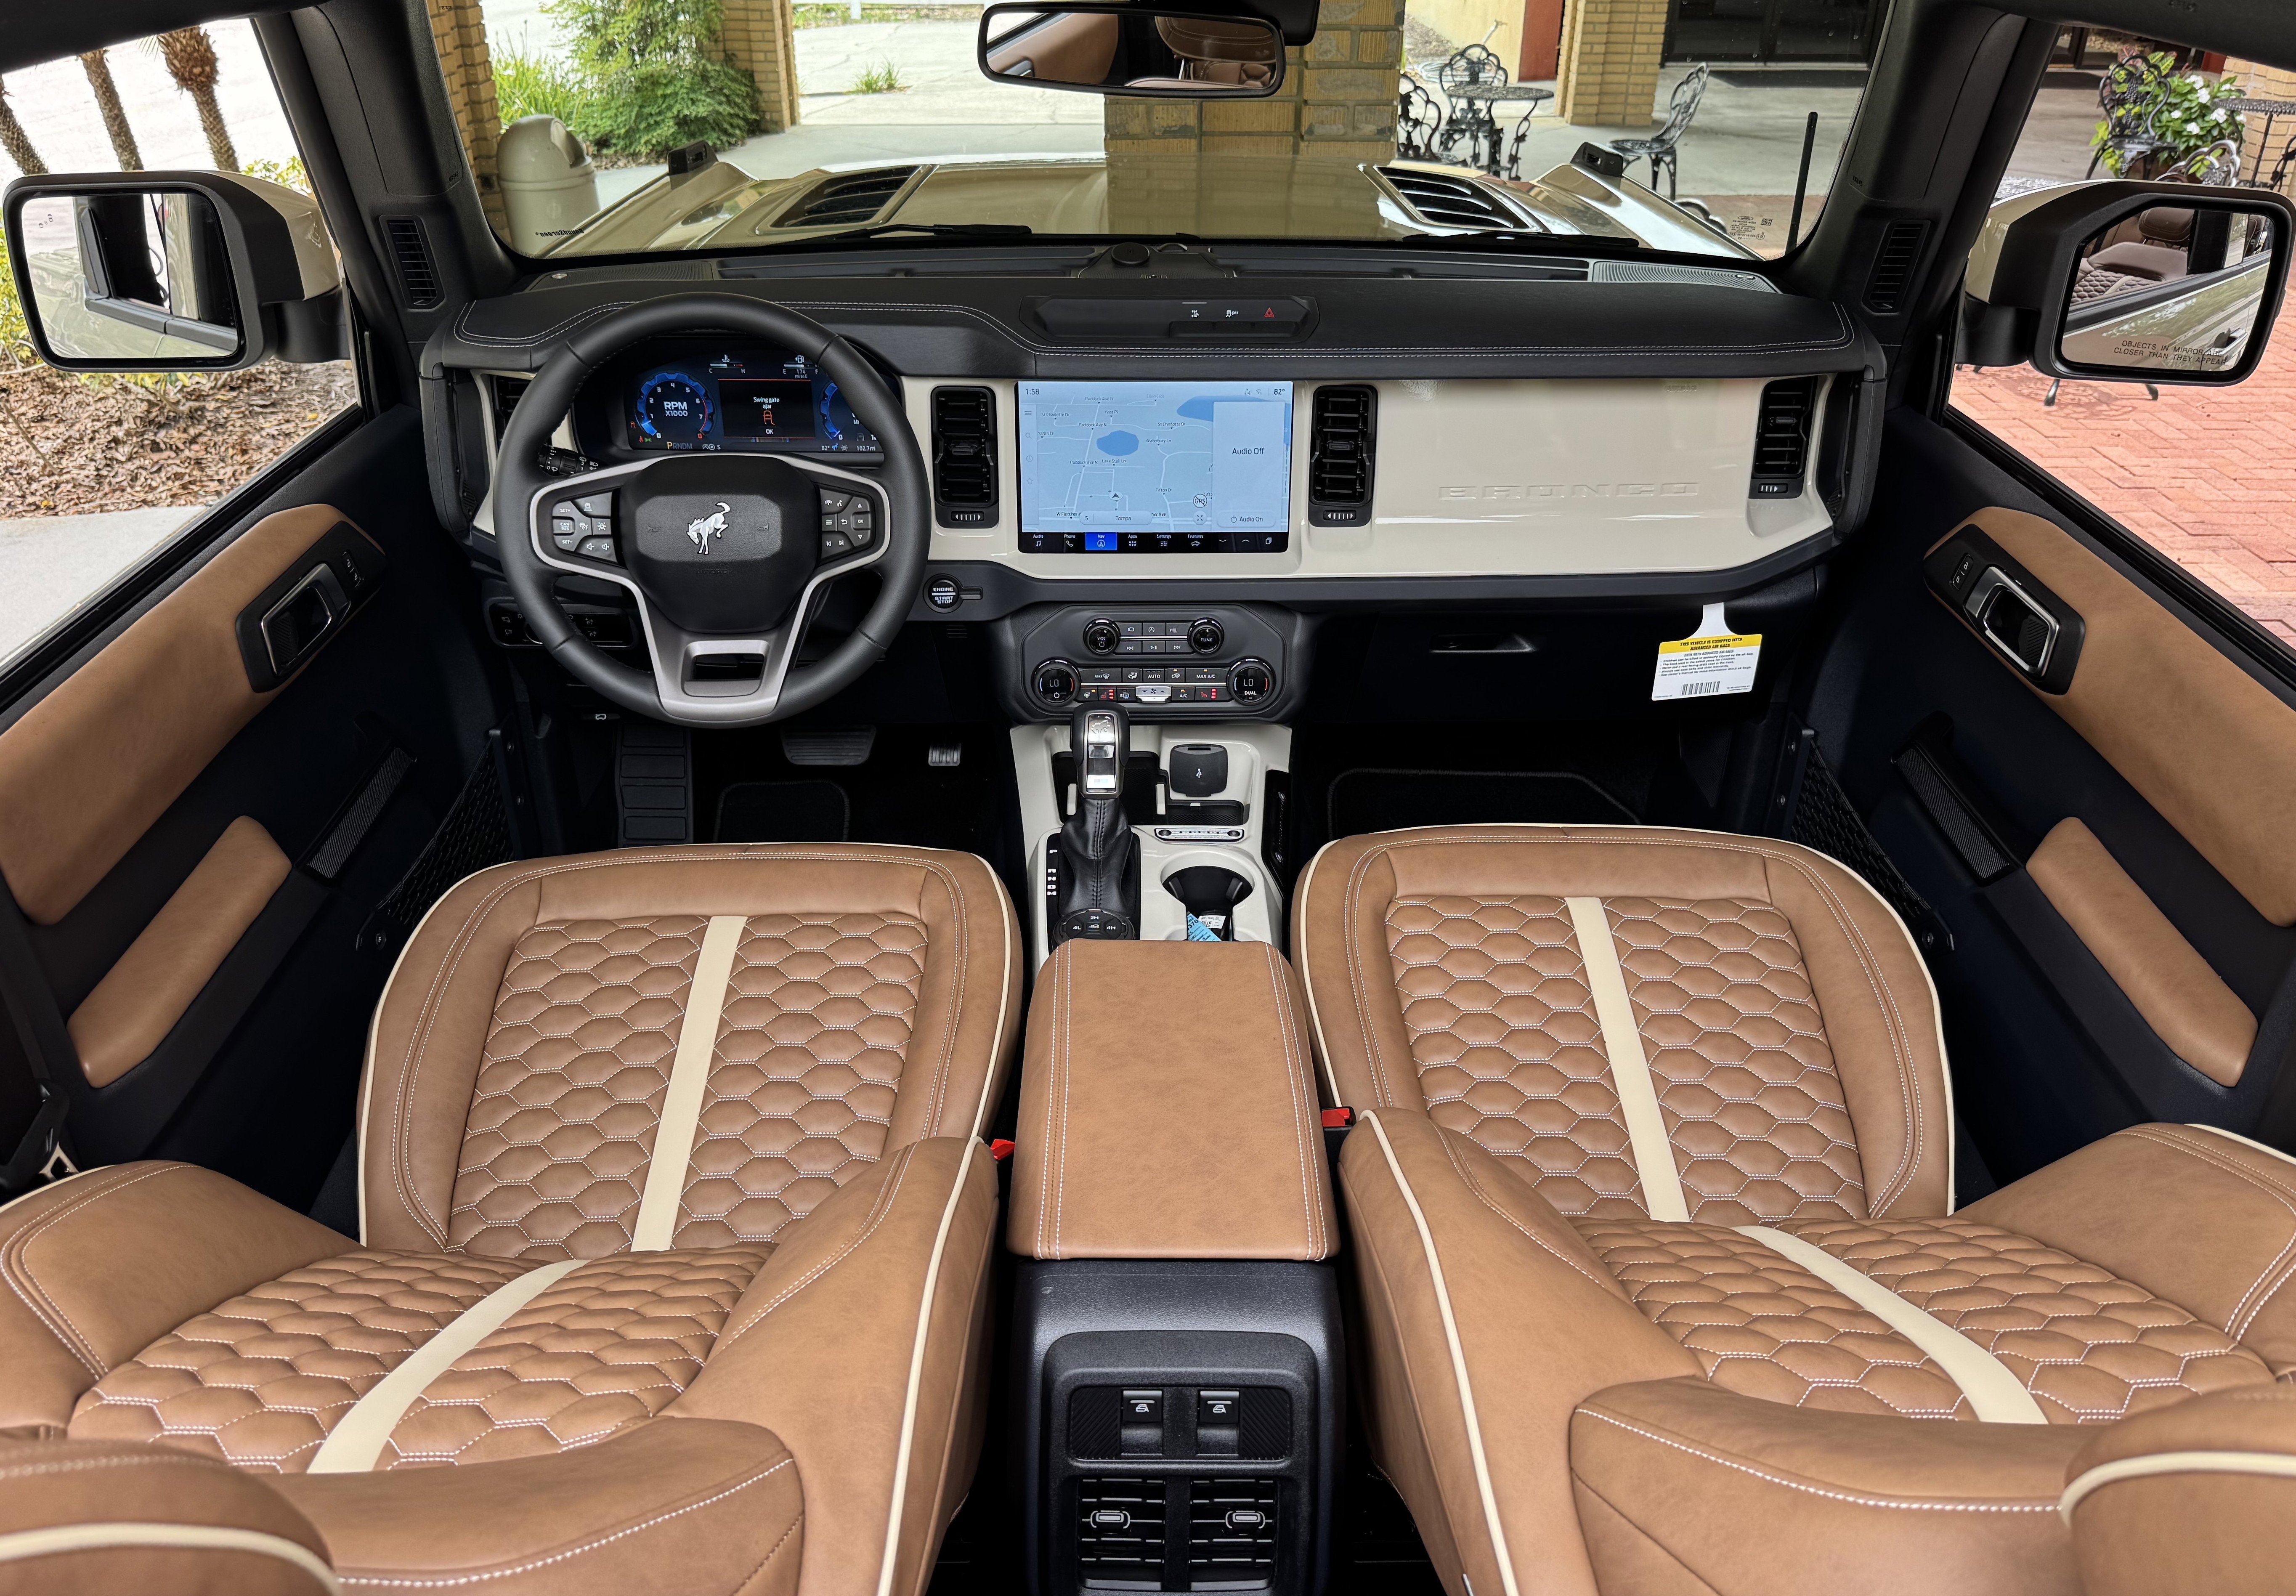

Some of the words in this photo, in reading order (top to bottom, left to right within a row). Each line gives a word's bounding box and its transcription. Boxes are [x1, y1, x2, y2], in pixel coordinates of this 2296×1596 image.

[2122, 340, 2157, 351] OBJECTS
[2173, 346, 2203, 356] MIRROR
[2114, 347, 2144, 357] CLOSER
[2148, 351, 2169, 359] THAN
[2173, 353, 2192, 362] THEY
[2195, 356, 2226, 366] APPEAR
[1439, 483, 1699, 499] BRONCO
